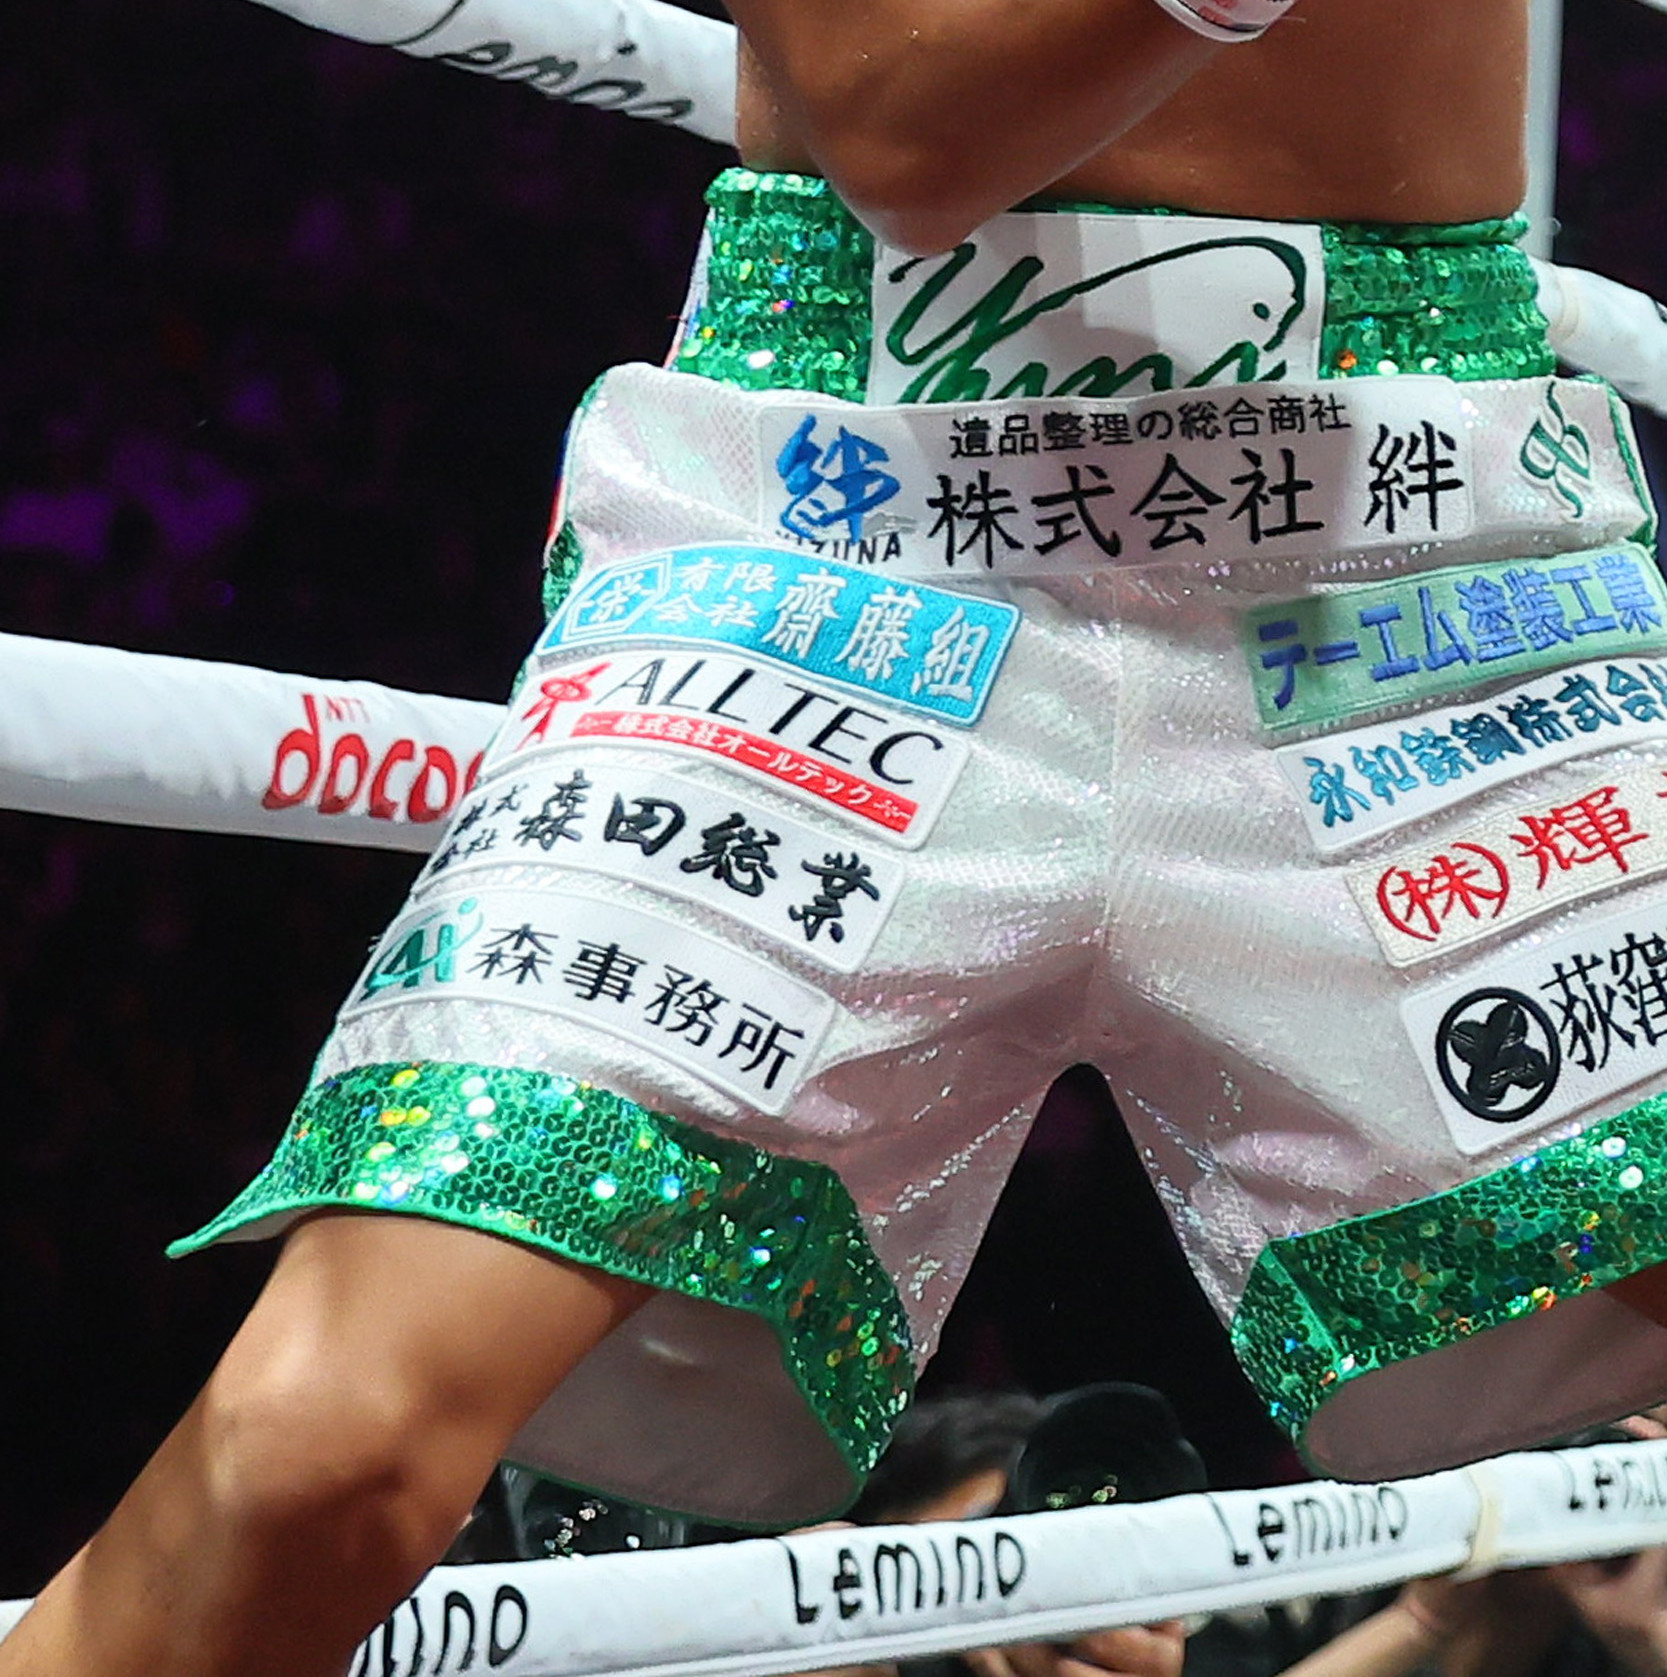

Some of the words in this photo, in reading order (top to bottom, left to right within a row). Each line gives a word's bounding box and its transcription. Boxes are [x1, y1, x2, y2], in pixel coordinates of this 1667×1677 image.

[948, 391, 1353, 462] 遺品整理の総合商社
[926, 446, 1325, 568] 株式会社
[1365, 418, 1468, 534] 絆
[262, 691, 484, 824] doco
[592, 656, 945, 787] ALLTEC
[612, 716, 874, 808] 株式会社オールテック
[465, 922, 807, 1091] 森事務所
[777, 1532, 1027, 1626] Lemino
[1209, 1482, 1410, 1566] Lemino
